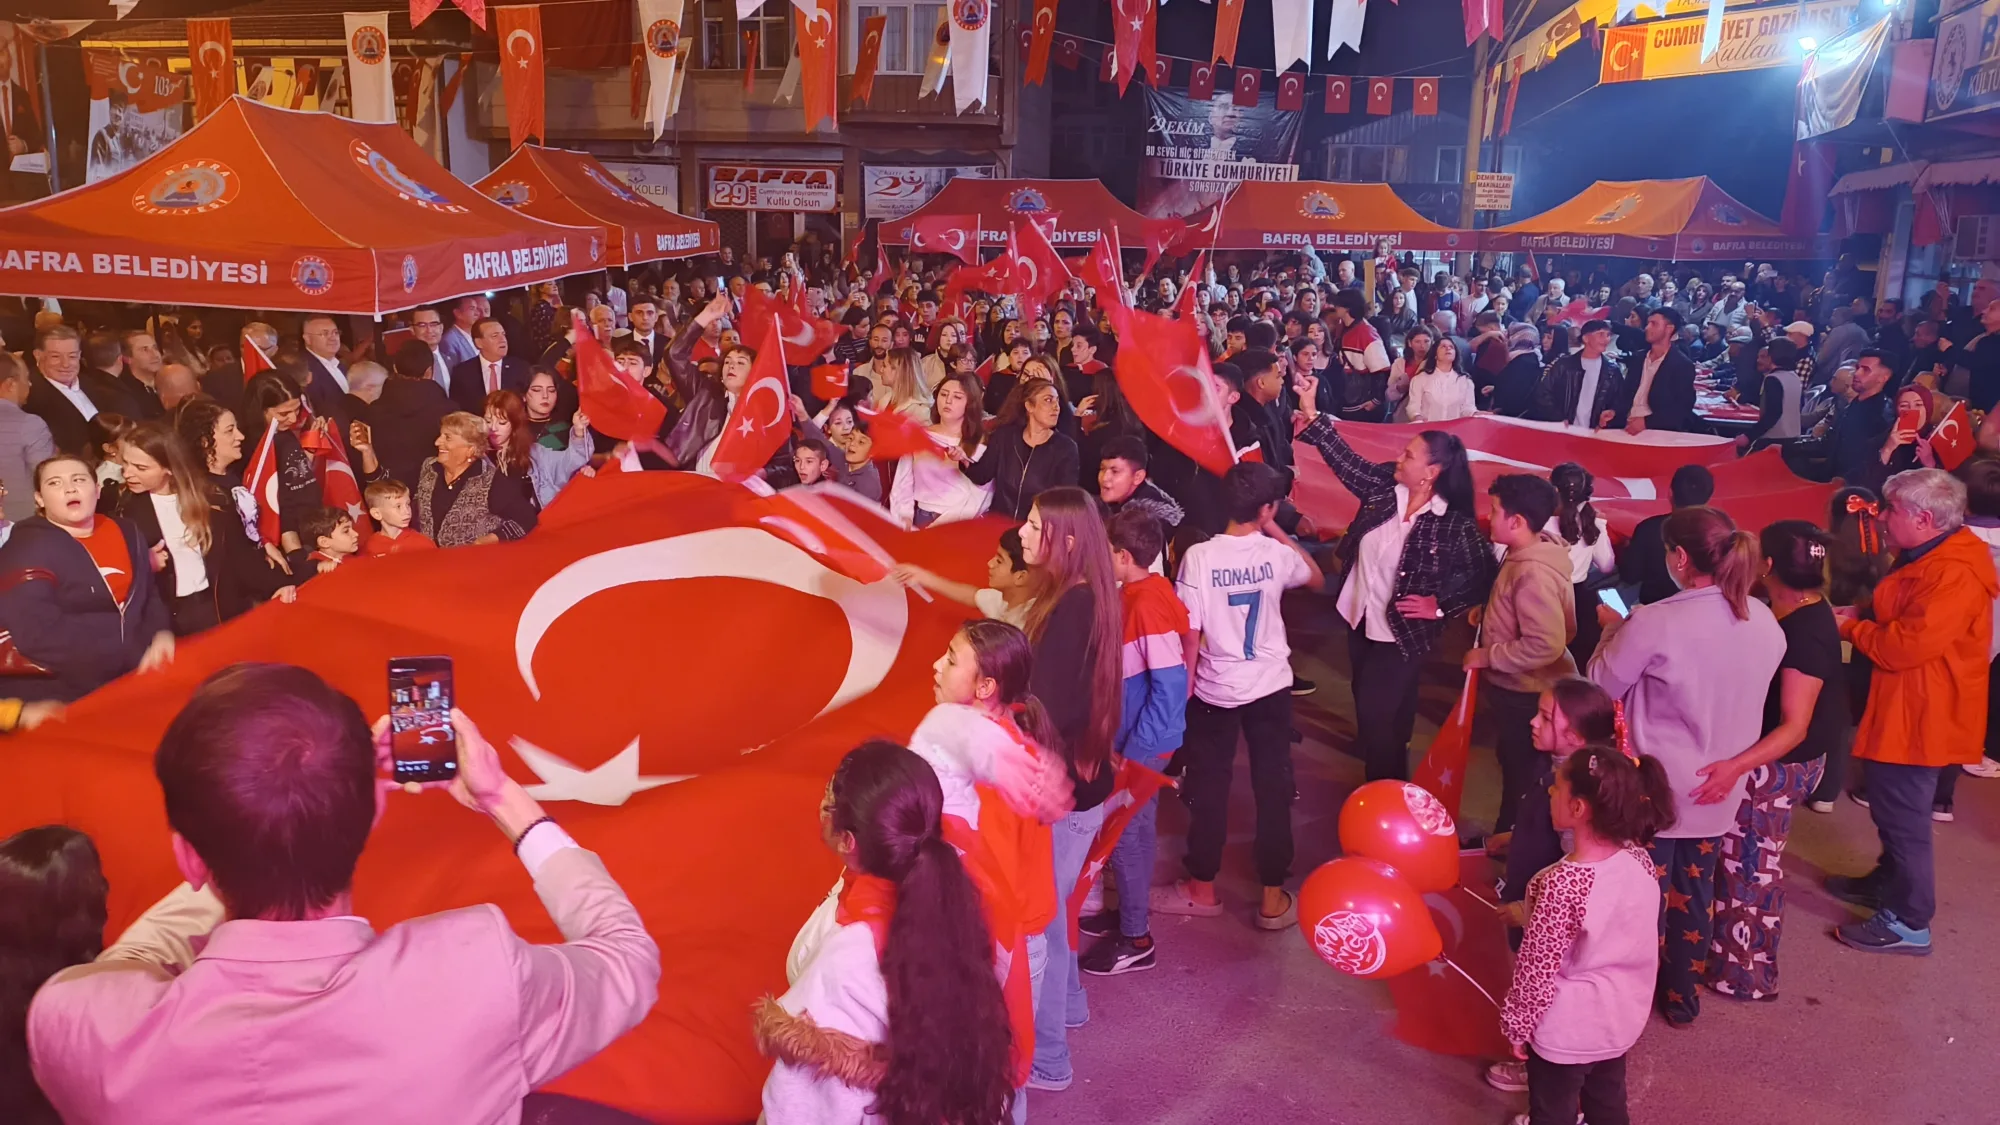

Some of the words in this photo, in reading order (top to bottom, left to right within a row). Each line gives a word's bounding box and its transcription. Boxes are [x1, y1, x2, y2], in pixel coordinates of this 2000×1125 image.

[1967, 67, 2000, 97] KÜLTÜ
[1148, 115, 1165, 133] 29
[1167, 119, 1205, 134] EKİM
[1146, 145, 1154, 156] BU
[1157, 146, 1178, 157] SEVGİ
[714, 167, 828, 184] BAFRA
[1160, 160, 1209, 178] TÜRKİYE
[1214, 163, 1293, 182] CUMHURİYETİ
[714, 182, 749, 206] 29
[758, 188, 792, 196] Cumhuriyet
[1189, 181, 1225, 193] SONSUZA
[766, 197, 790, 206] Kutlu
[794, 198, 820, 208] Olsun
[1052, 228, 1101, 242] DİYESİ
[1262, 233, 1312, 244] BAFRA
[1521, 236, 1550, 248] BAFRA
[1553, 234, 1615, 250] BELEDİYESİ
[464, 250, 511, 280] BAFRA
[512, 237, 568, 274] BELEDİYESİ
[0, 250, 84, 272] AFRA
[92, 253, 268, 285] BELEDİYESİ
[1227, 588, 1264, 661] 7
